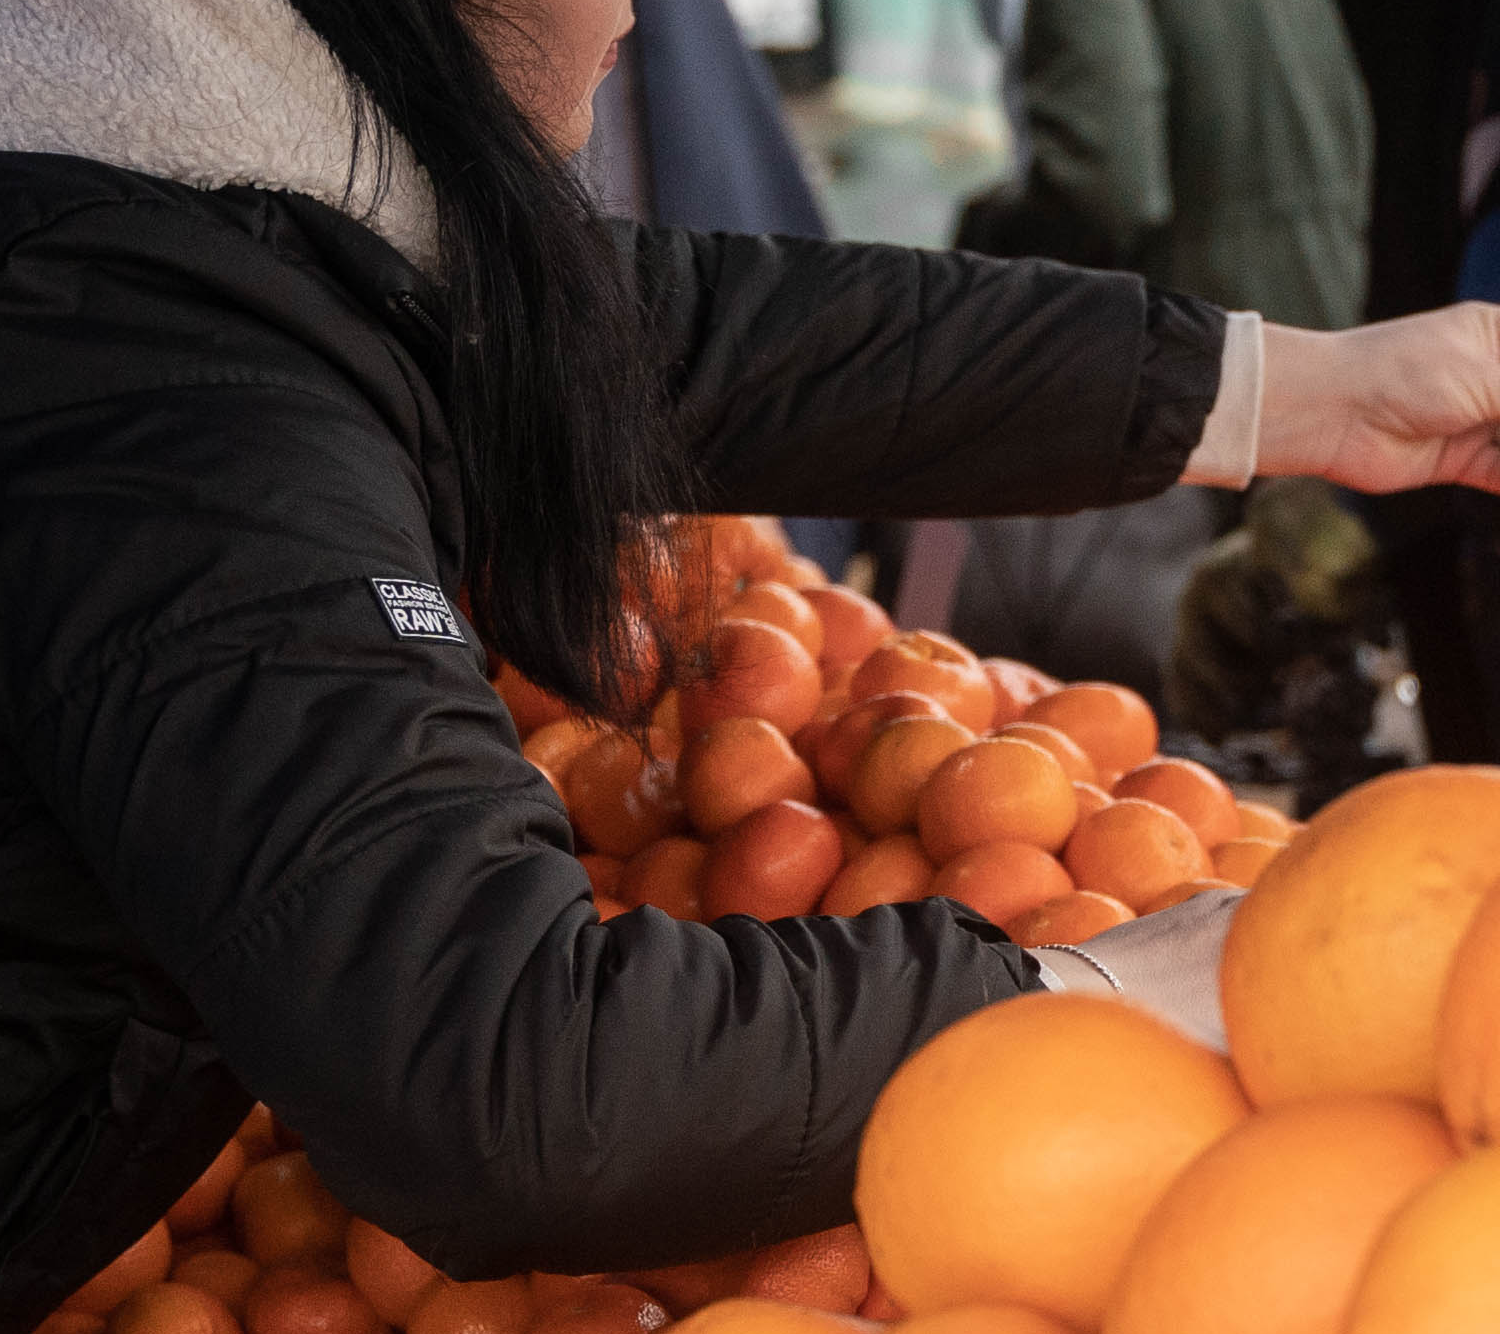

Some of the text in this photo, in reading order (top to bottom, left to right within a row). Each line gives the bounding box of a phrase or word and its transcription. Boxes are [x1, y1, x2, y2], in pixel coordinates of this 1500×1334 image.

[380, 584, 444, 606] CLASSIC
[386, 599, 424, 608] FASHION
[393, 608, 443, 633] RAW
